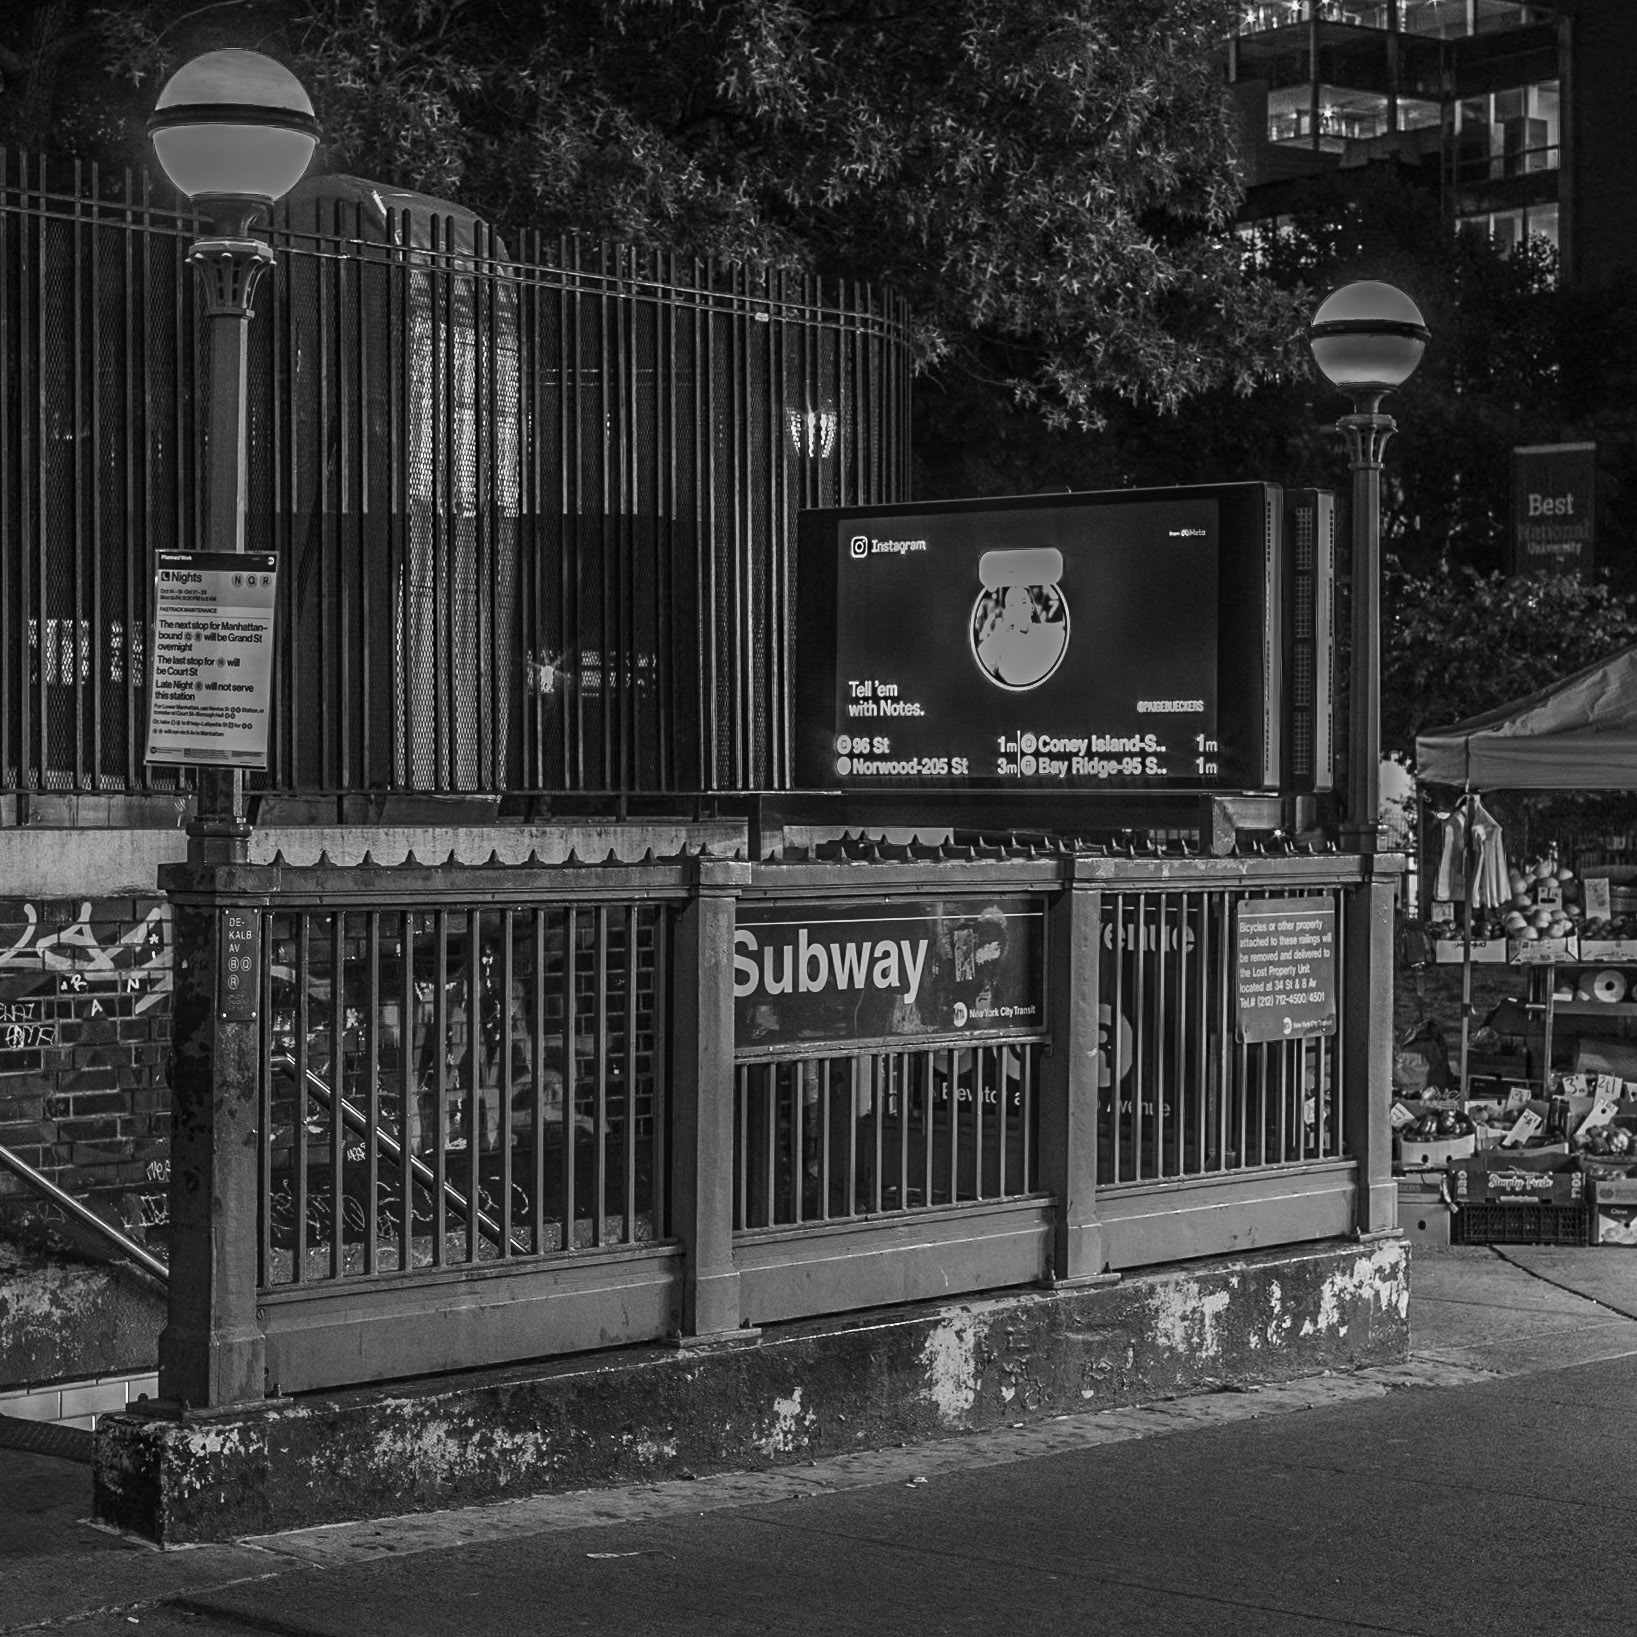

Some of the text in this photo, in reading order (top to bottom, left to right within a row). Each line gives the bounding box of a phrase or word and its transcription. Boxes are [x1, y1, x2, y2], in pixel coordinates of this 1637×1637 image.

[1528, 492, 1574, 517] Best
[871, 539, 927, 555] Instagram
[171, 571, 202, 585] Nights
[159, 619, 174, 630] The
[174, 620, 191, 630] next
[191, 621, 209, 632] stop
[209, 621, 221, 631] for
[158, 631, 183, 641] bound
[203, 632, 217, 642] will
[216, 633, 228, 642] be
[227, 633, 253, 643] Grand
[253, 633, 263, 644] St
[157, 642, 193, 653] overnight
[157, 654, 173, 665] The
[172, 655, 187, 665] last
[186, 656, 204, 668] stop
[203, 656, 216, 666] for
[226, 657, 241, 667] will
[156, 666, 199, 677] be Court St
[155, 679, 173, 689] Late
[172, 680, 194, 691] Night
[204, 681, 218, 691] will
[217, 683, 232, 692] not
[232, 684, 255, 693] serve
[848, 680, 872, 697] Tell
[154, 690, 196, 701] this station
[848, 700, 926, 717] with Notes.
[852, 737, 870, 754] 96
[872, 737, 890, 754] St
[1038, 734, 1089, 756] Coney
[852, 757, 948, 775] Norwood-205
[951, 757, 969, 775] St
[1038, 757, 1069, 778] Bay
[1072, 756, 1142, 778] Ridge-95
[1240, 919, 1323, 934] Bicycles or other property
[229, 930, 252, 940] KALB
[1240, 932, 1332, 948] attached to these railings will
[229, 944, 241, 953] AV
[1240, 947, 1331, 963] be removed and delivered to
[734, 928, 929, 1004] Subway
[1240, 963, 1311, 978] the Lost Property Unit
[1240, 981, 1265, 993] located
[1265, 981, 1273, 991] at
[1274, 979, 1284, 991] 34
[1285, 979, 1293, 990] St
[1294, 978, 1300, 989] &
[1301, 977, 1307, 989] 8
[1257, 994, 1274, 1008] (212)
[969, 1004, 1036, 1018] New York City Transit
